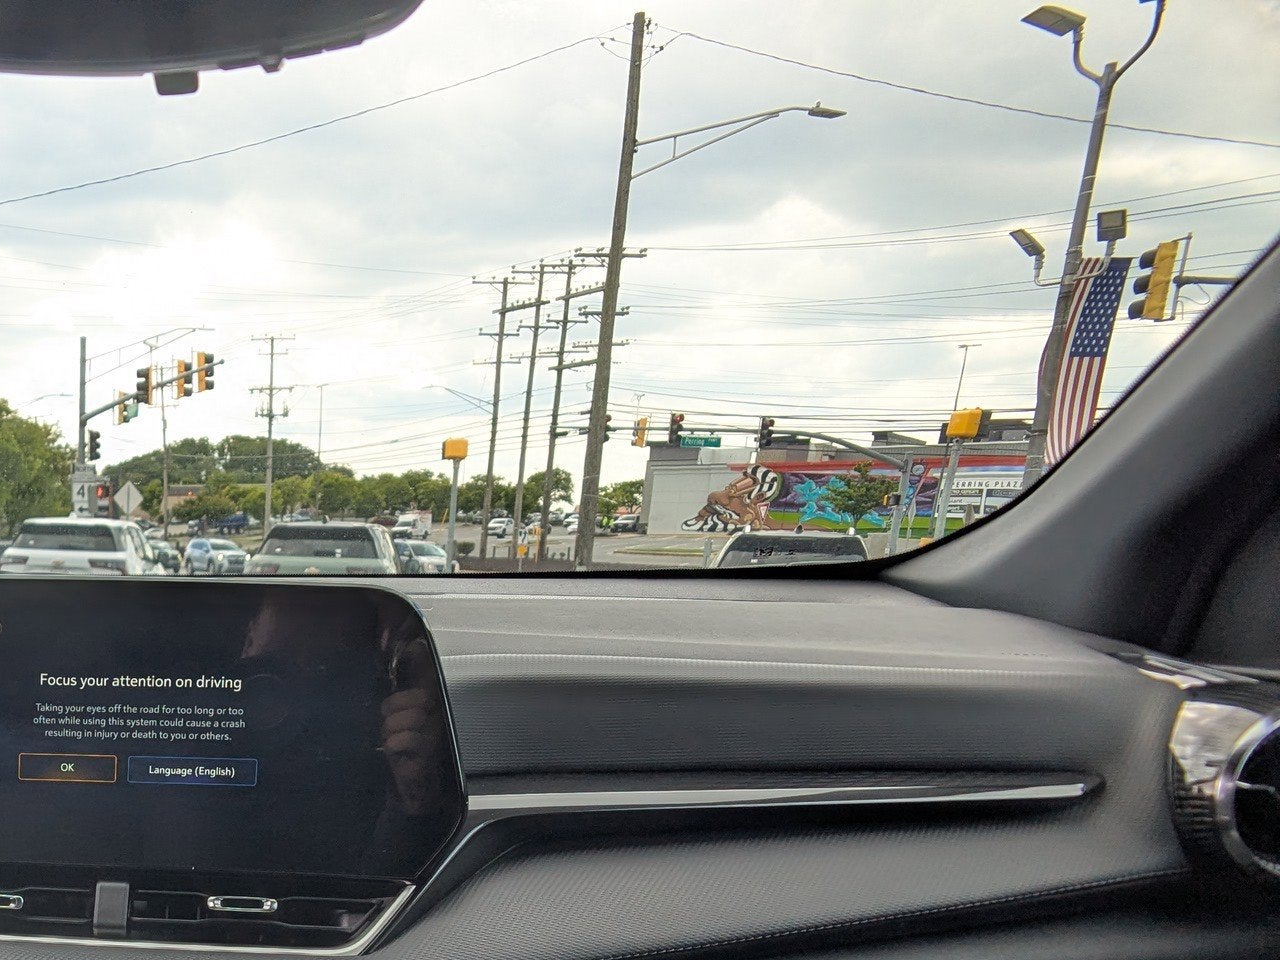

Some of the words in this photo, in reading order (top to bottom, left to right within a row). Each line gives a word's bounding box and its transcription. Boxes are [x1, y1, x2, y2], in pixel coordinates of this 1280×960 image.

[40, 673, 77, 687] Focus
[79, 677, 109, 689] your
[112, 675, 172, 688] attention
[175, 678, 193, 688] on
[196, 675, 242, 691] driving
[36, 703, 64, 714] Taking
[65, 705, 84, 714] your
[86, 705, 107, 715] eyes
[108, 704, 122, 713] off
[123, 704, 138, 713] the
[139, 705, 160, 714] road
[162, 704, 176, 714] for
[177, 706, 193, 715] too
[194, 705, 215, 717] long
[228, 707, 244, 715] too
[33, 715, 56, 724] often
[58, 716, 81, 725] while
[82, 717, 106, 728] using
[108, 717, 125, 726] this
[126, 718, 157, 728] system
[159, 718, 184, 727] could
[185, 720, 212, 728] cause
[213, 720, 219, 728] a
[221, 719, 246, 728] crash
[44, 729, 82, 740] resulting
[84, 729, 92, 738] in
[94, 729, 119, 740] injury
[120, 731, 130, 739] or
[131, 730, 157, 739] death
[159, 731, 169, 739] to
[170, 733, 187, 742] you
[188, 732, 199, 740] or
[200, 731, 232, 741] others.
[60, 763, 75, 772] OK
[149, 765, 193, 776] Language
[195, 766, 235, 778] (English)
